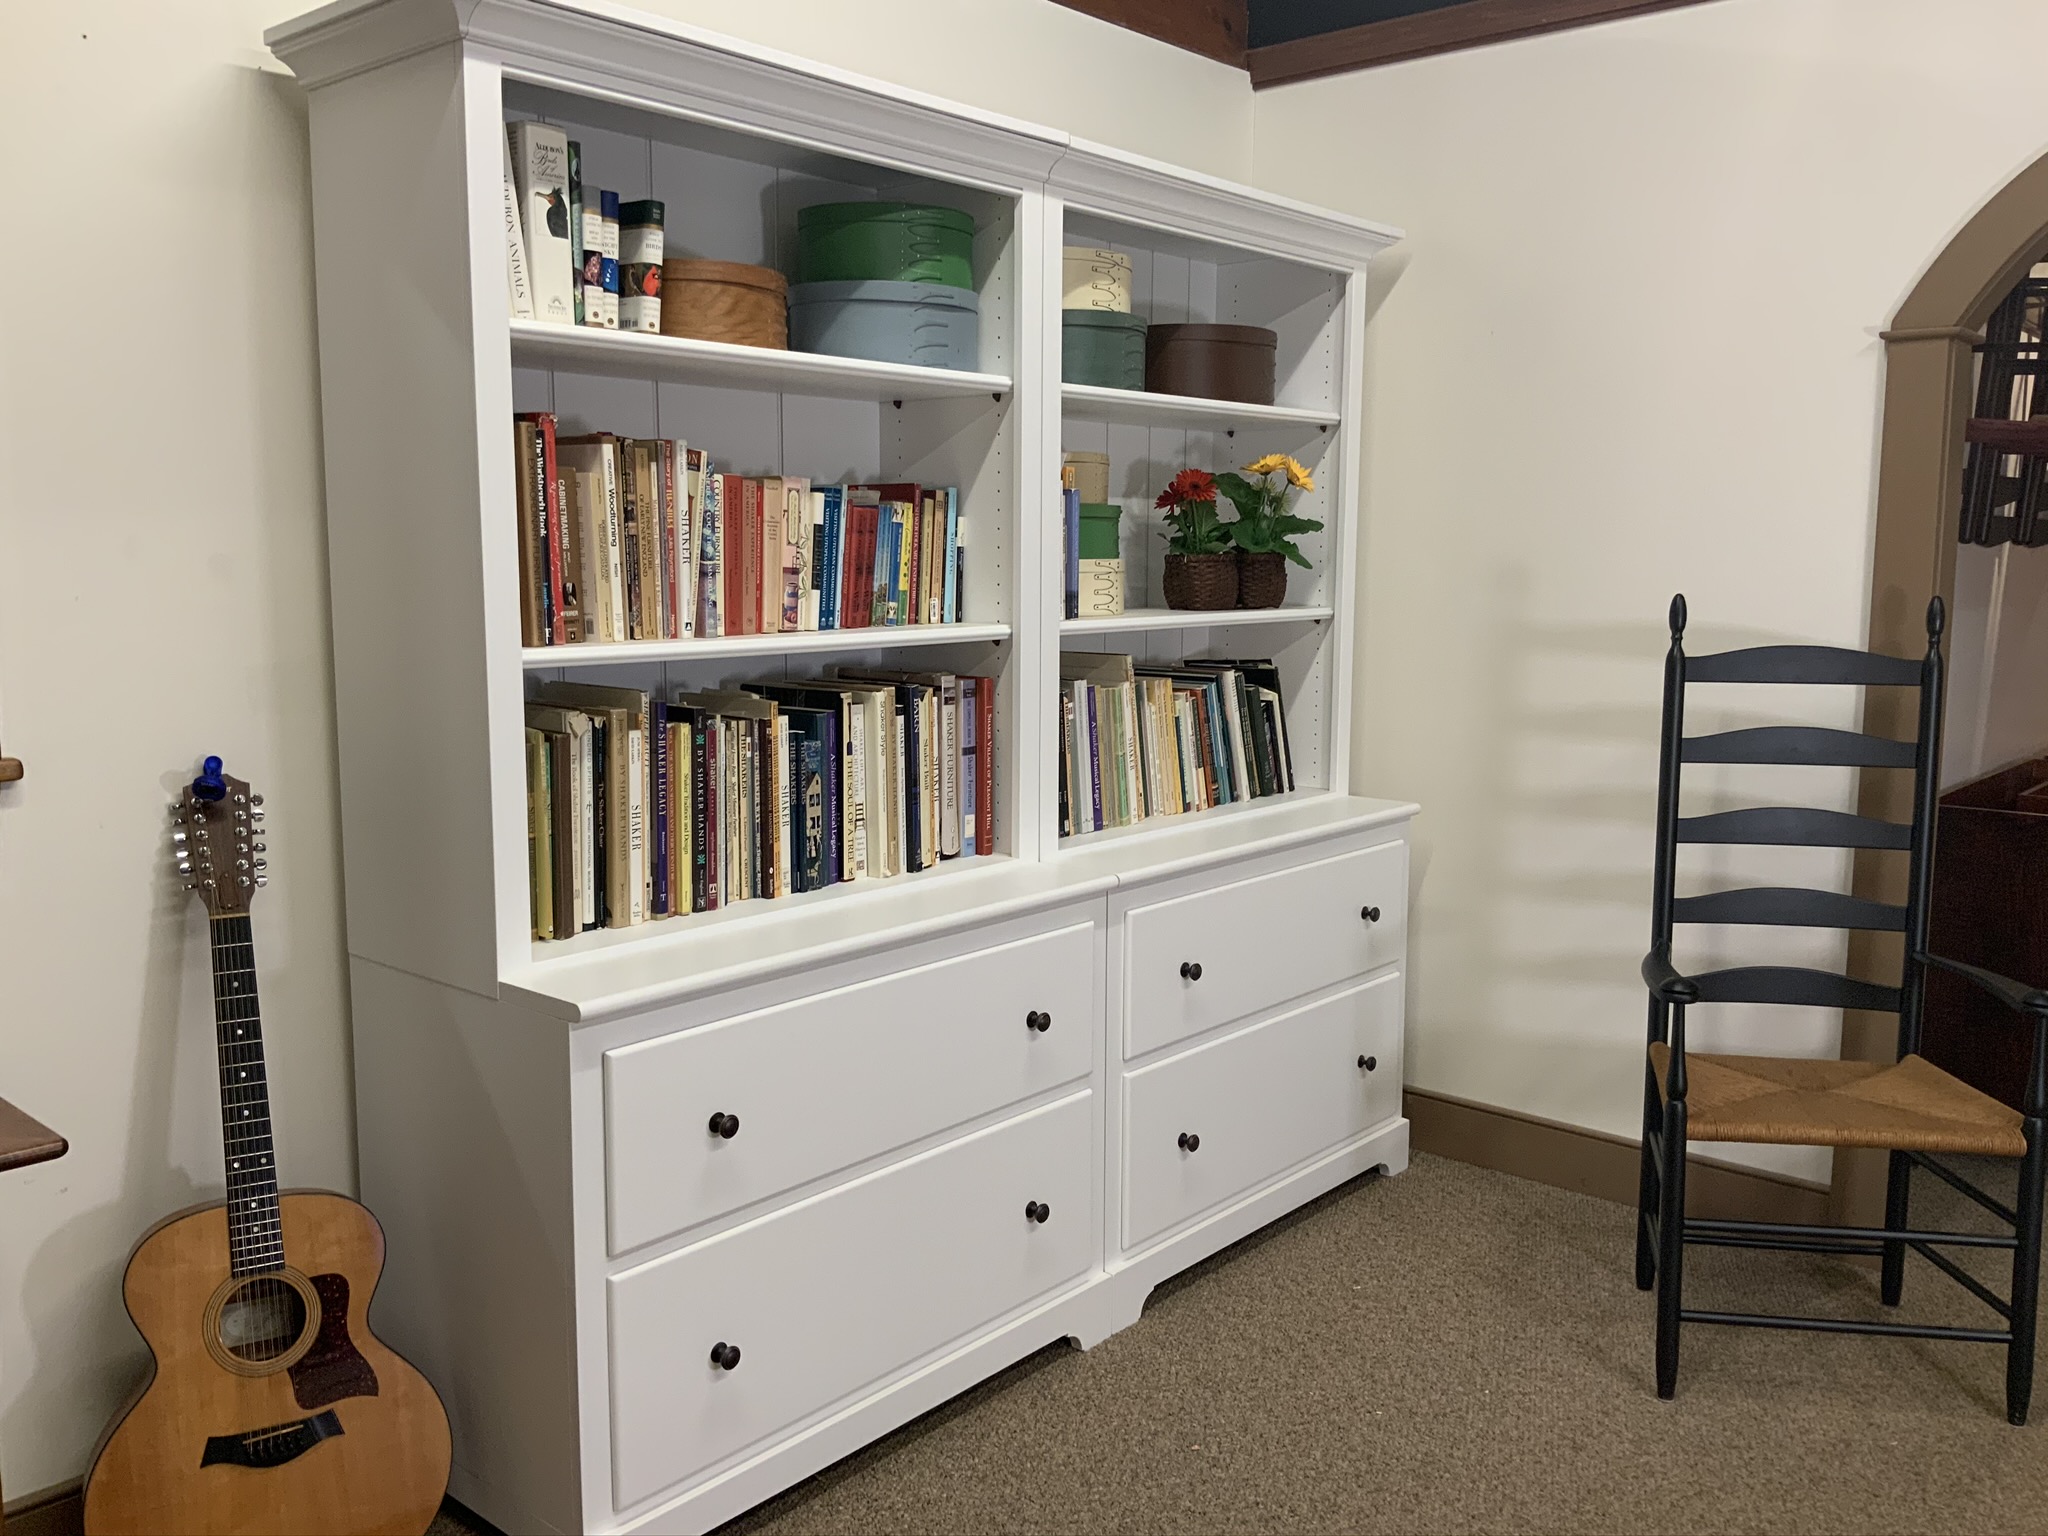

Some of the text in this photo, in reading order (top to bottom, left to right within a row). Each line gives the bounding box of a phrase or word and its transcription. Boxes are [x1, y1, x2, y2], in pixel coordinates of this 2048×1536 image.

[508, 240, 526, 298] ANIMALS
[604, 248, 616, 256] SKY
[528, 458, 540, 543] EXTRAORDINARY
[538, 458, 546, 510] Workbench
[558, 478, 570, 550] CABINETMAKING
[609, 488, 617, 547] Woodturning
[682, 510, 690, 564] SHAKER
[619, 764, 626, 778] BY
[698, 750, 704, 763] BY
[632, 804, 641, 851] SHAKER
[781, 785, 790, 828] SHAKER
[848, 812, 854, 828] OF
